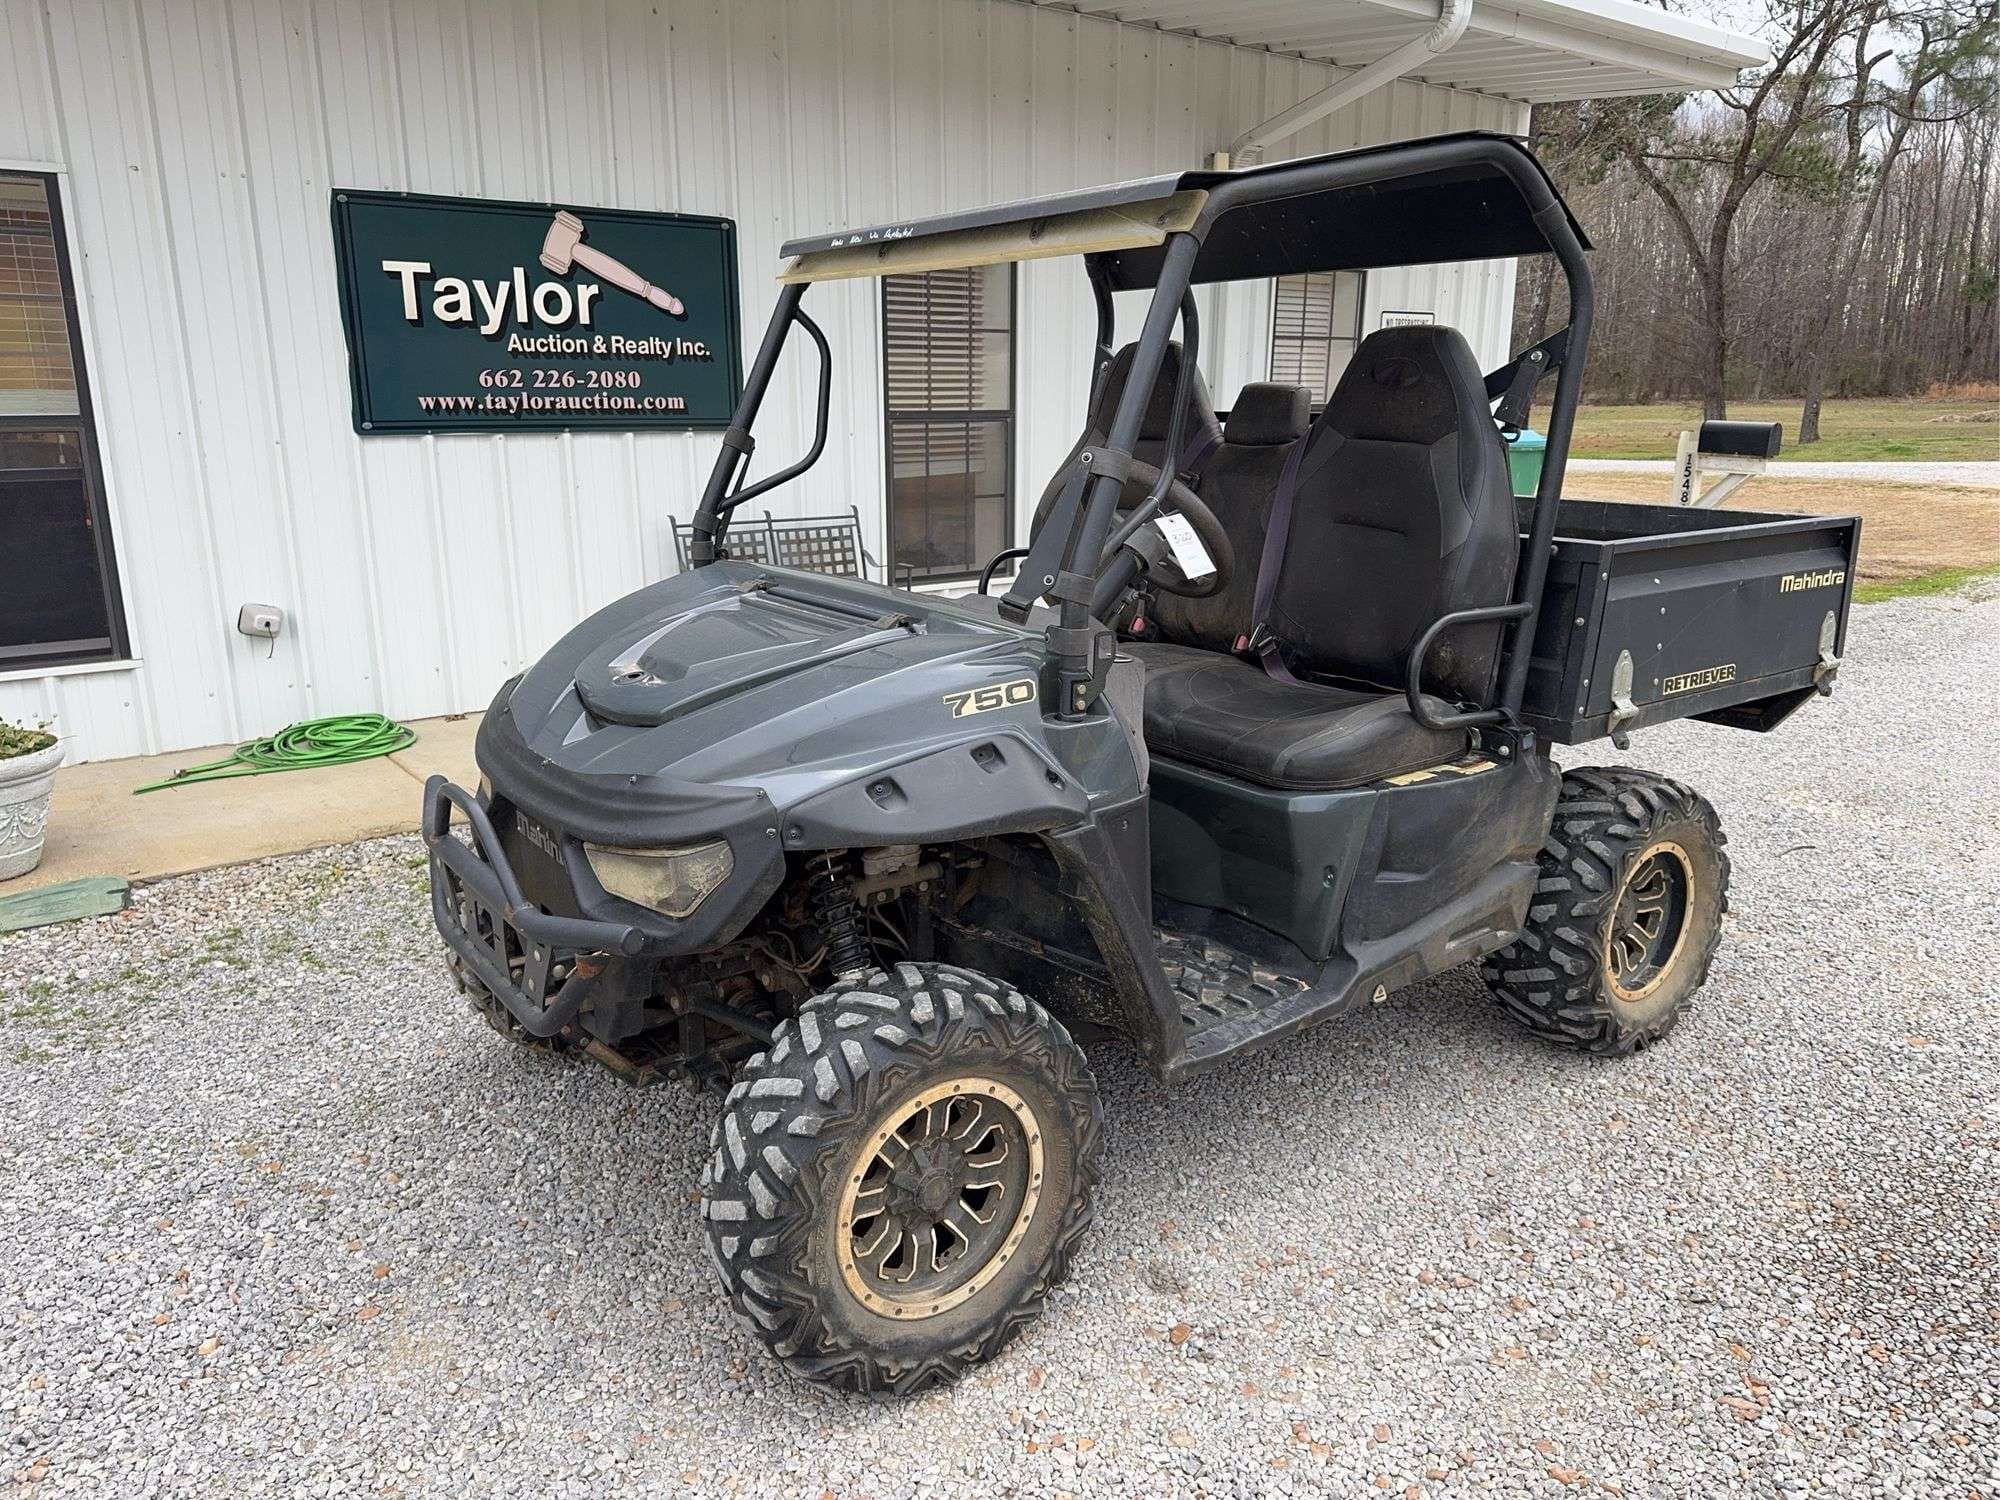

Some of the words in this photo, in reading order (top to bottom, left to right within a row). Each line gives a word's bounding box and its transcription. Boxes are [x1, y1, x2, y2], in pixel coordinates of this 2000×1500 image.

[382, 260, 599, 335] Taylor
[507, 333, 588, 354] Auction
[593, 337, 607, 354] &
[611, 336, 672, 358] Realty
[677, 338, 711, 356] Inc.
[479, 369, 524, 389] 662
[533, 369, 641, 389] 226-2080
[418, 391, 685, 414] www.taylorauction.com
[1680, 453, 1693, 506] 1548
[1780, 570, 1845, 593] Mahindra
[1663, 664, 1736, 694] RETRIEVER
[944, 680, 1035, 717] 750
[516, 809, 564, 866] Mahin
